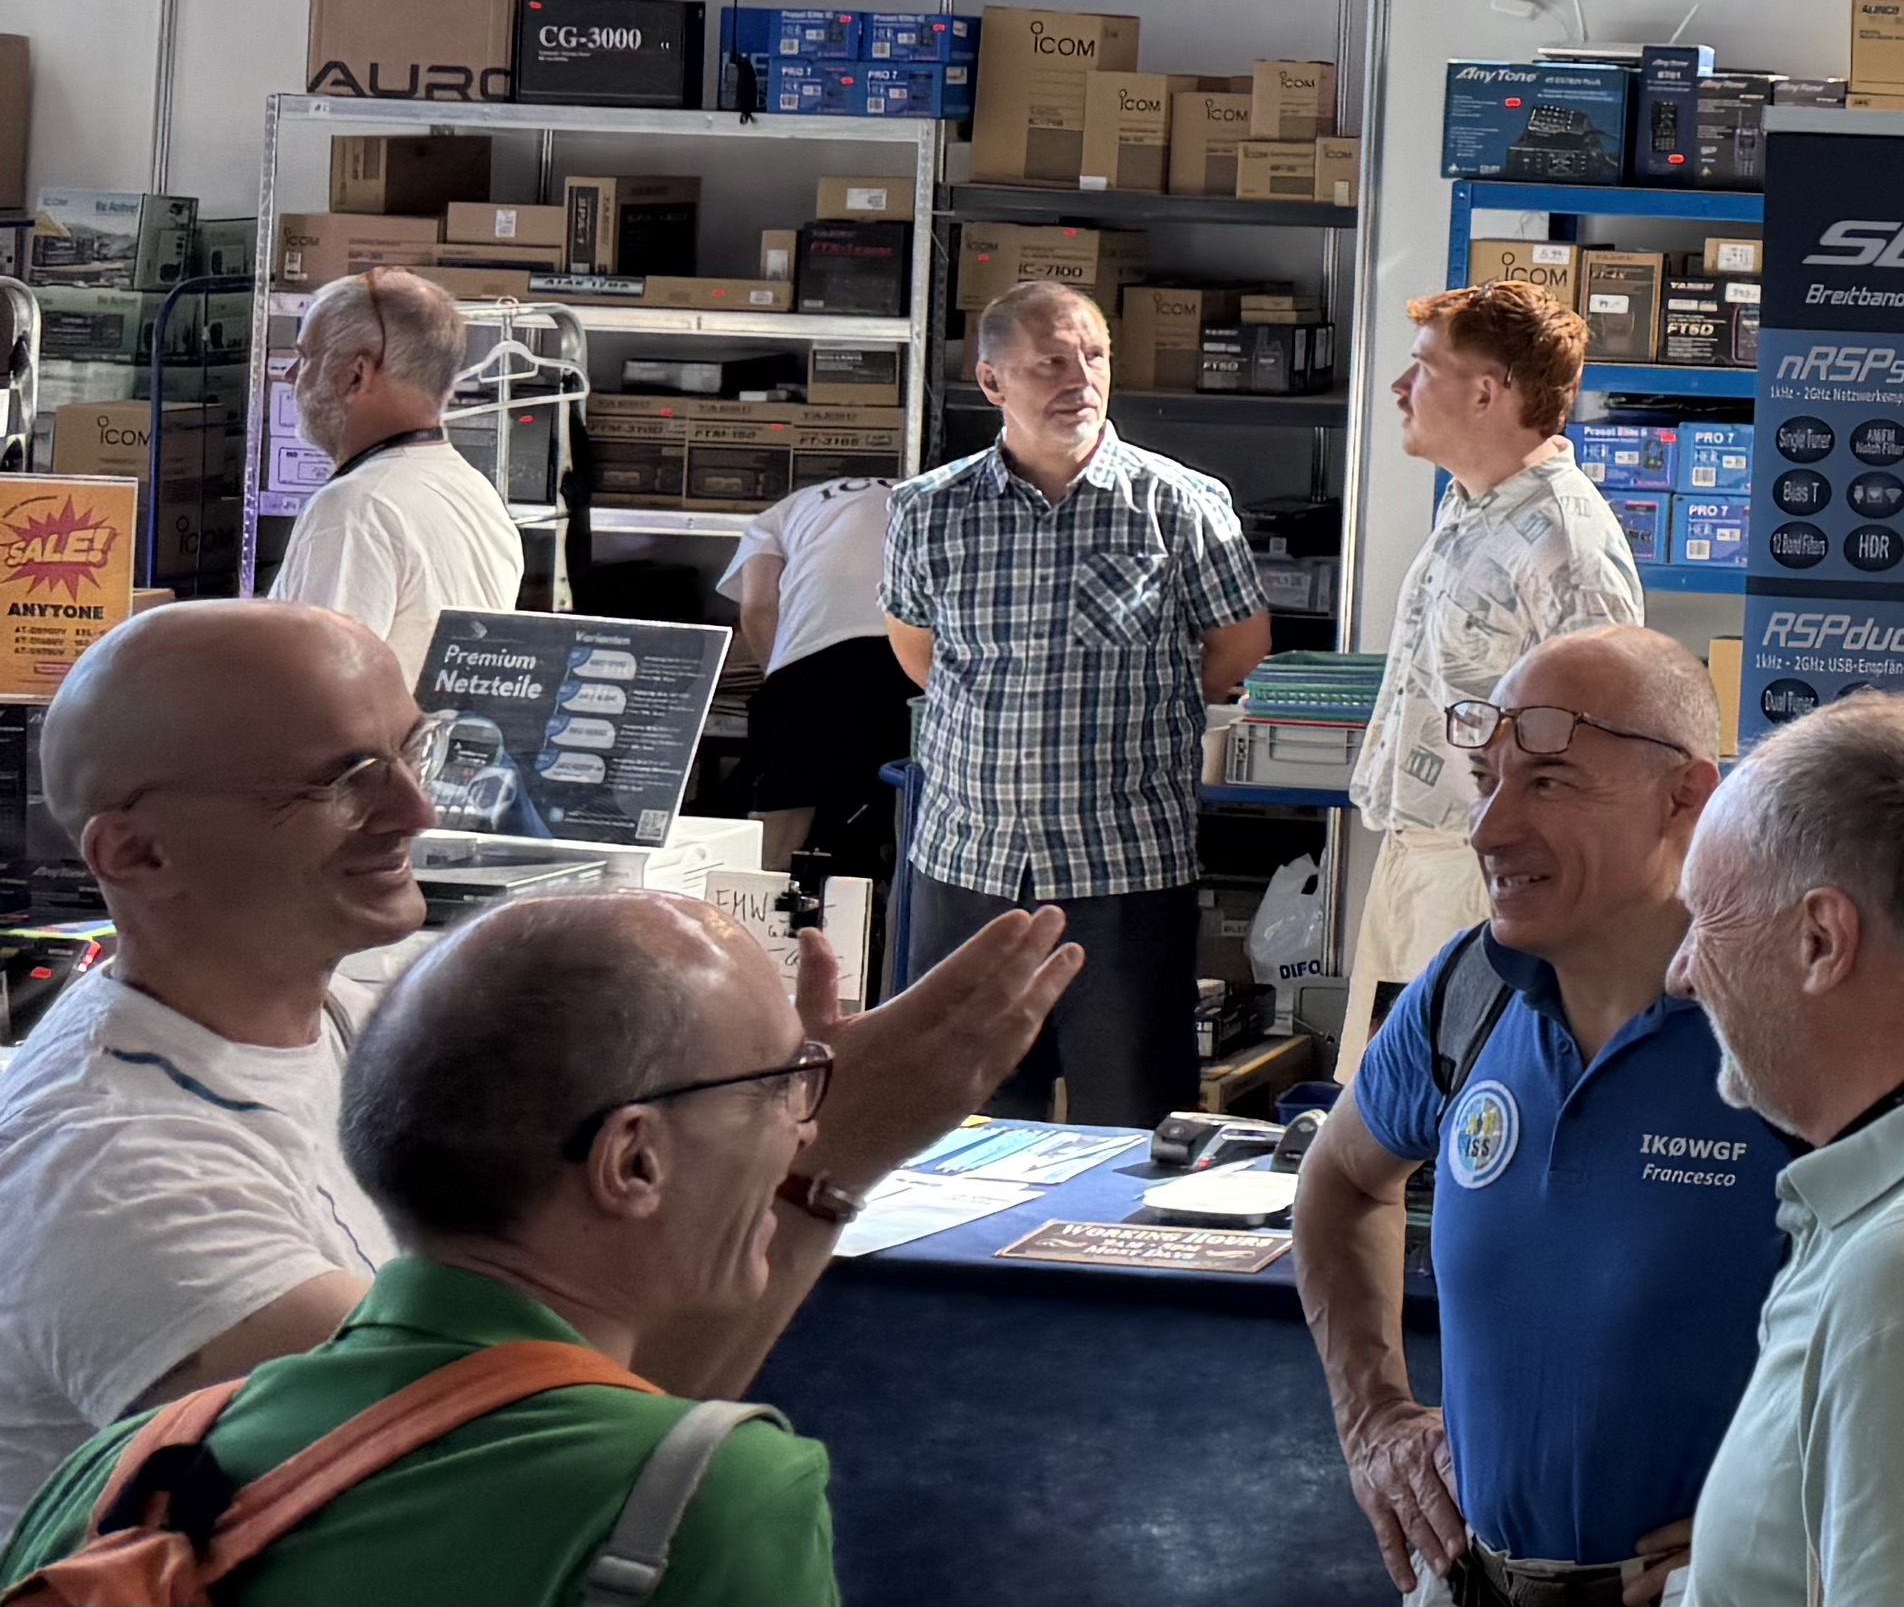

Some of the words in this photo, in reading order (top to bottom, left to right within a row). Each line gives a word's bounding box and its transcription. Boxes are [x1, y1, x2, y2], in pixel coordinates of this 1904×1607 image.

[539, 25, 641, 50] CG-3000
[1456, 67, 1537, 83] AnyTone
[1018, 264, 1083, 278] IC-7100
[1695, 432, 1724, 444] PRO
[1728, 432, 1735, 444] 7
[1783, 483, 1808, 502] Bias
[1810, 483, 1820, 502] T
[1689, 505, 1718, 516] PRO
[1721, 505, 1728, 516] 7
[5, 527, 116, 568] SALE!
[1858, 535, 1890, 559] HDR
[8, 603, 104, 620] ANYTONE
[444, 645, 536, 669] Premium
[1795, 657, 1825, 672] 2GHz
[435, 669, 543, 699] Netzteile
[1765, 692, 1786, 712] Dual
[1465, 1137, 1491, 1158] ISS
[1642, 1163, 1736, 1187] Francesco
[1062, 1224, 1184, 1244] WORKING
[1186, 1232, 1274, 1248] HOURS
